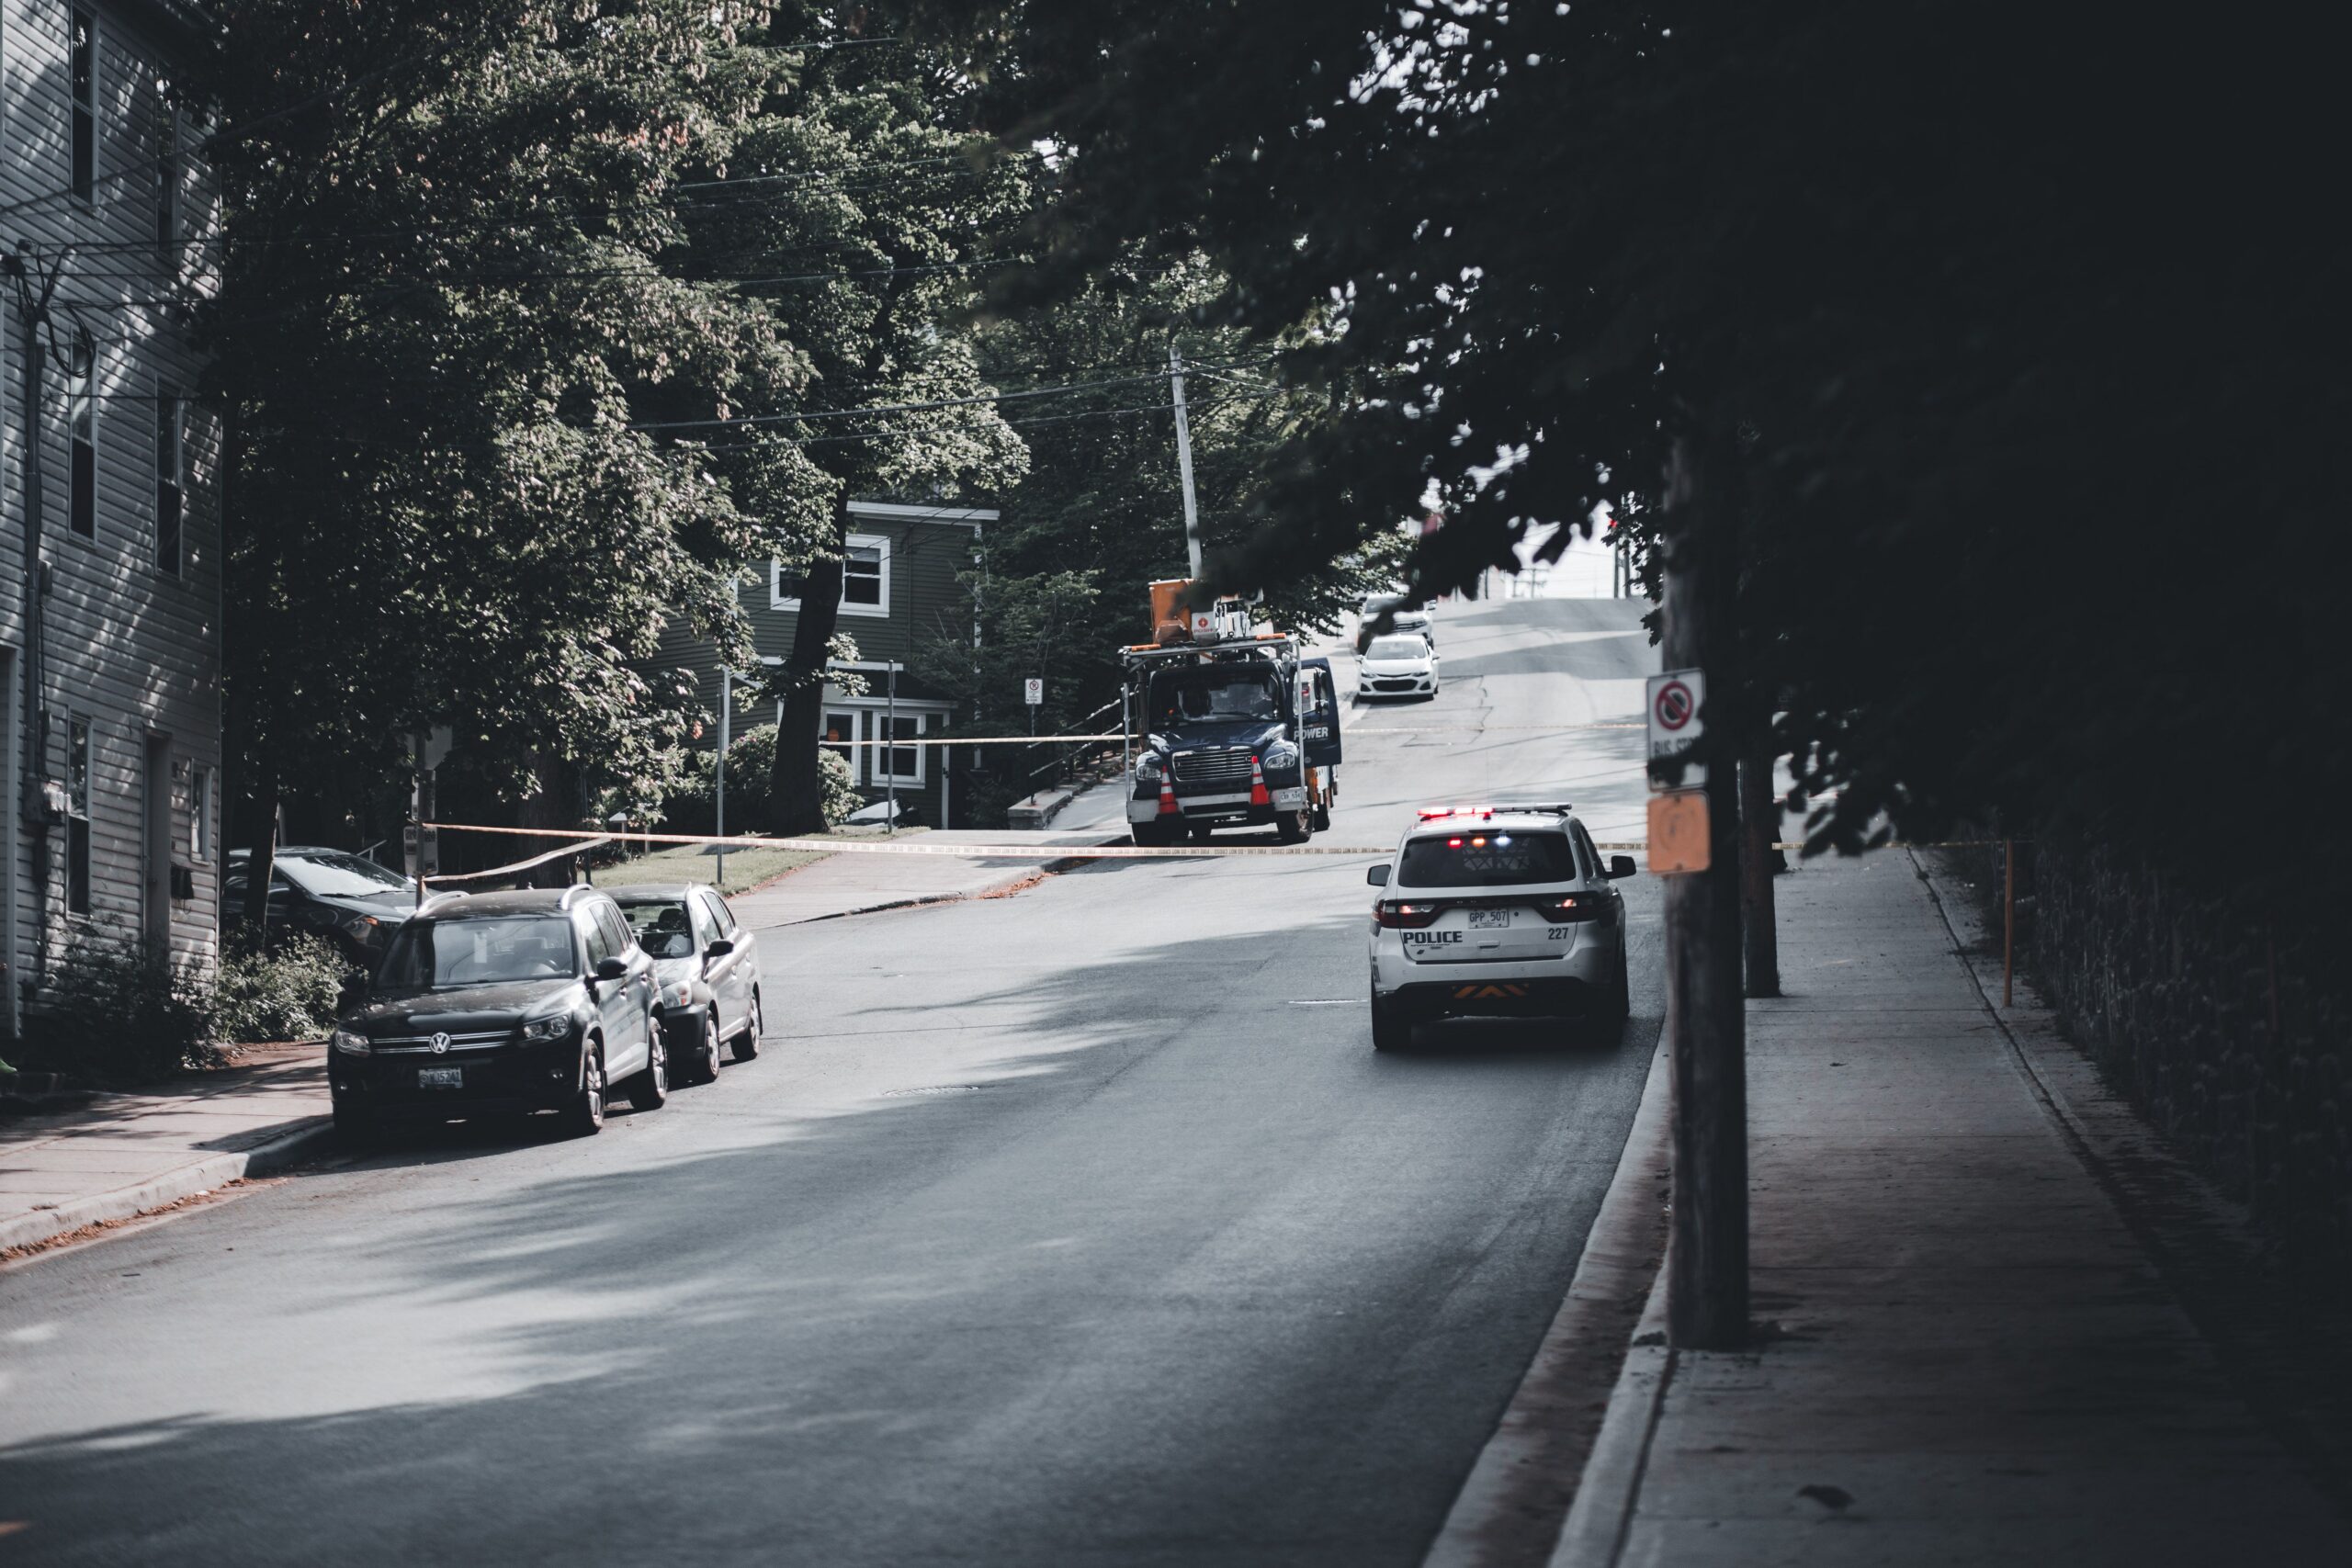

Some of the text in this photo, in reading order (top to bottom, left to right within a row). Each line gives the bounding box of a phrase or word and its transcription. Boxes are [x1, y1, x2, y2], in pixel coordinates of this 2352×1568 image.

[1294, 727, 1329, 741] POWER
[1470, 910, 1507, 922] GPP 507
[1403, 931, 1463, 944] POLICE
[1548, 928, 1569, 941] 227
